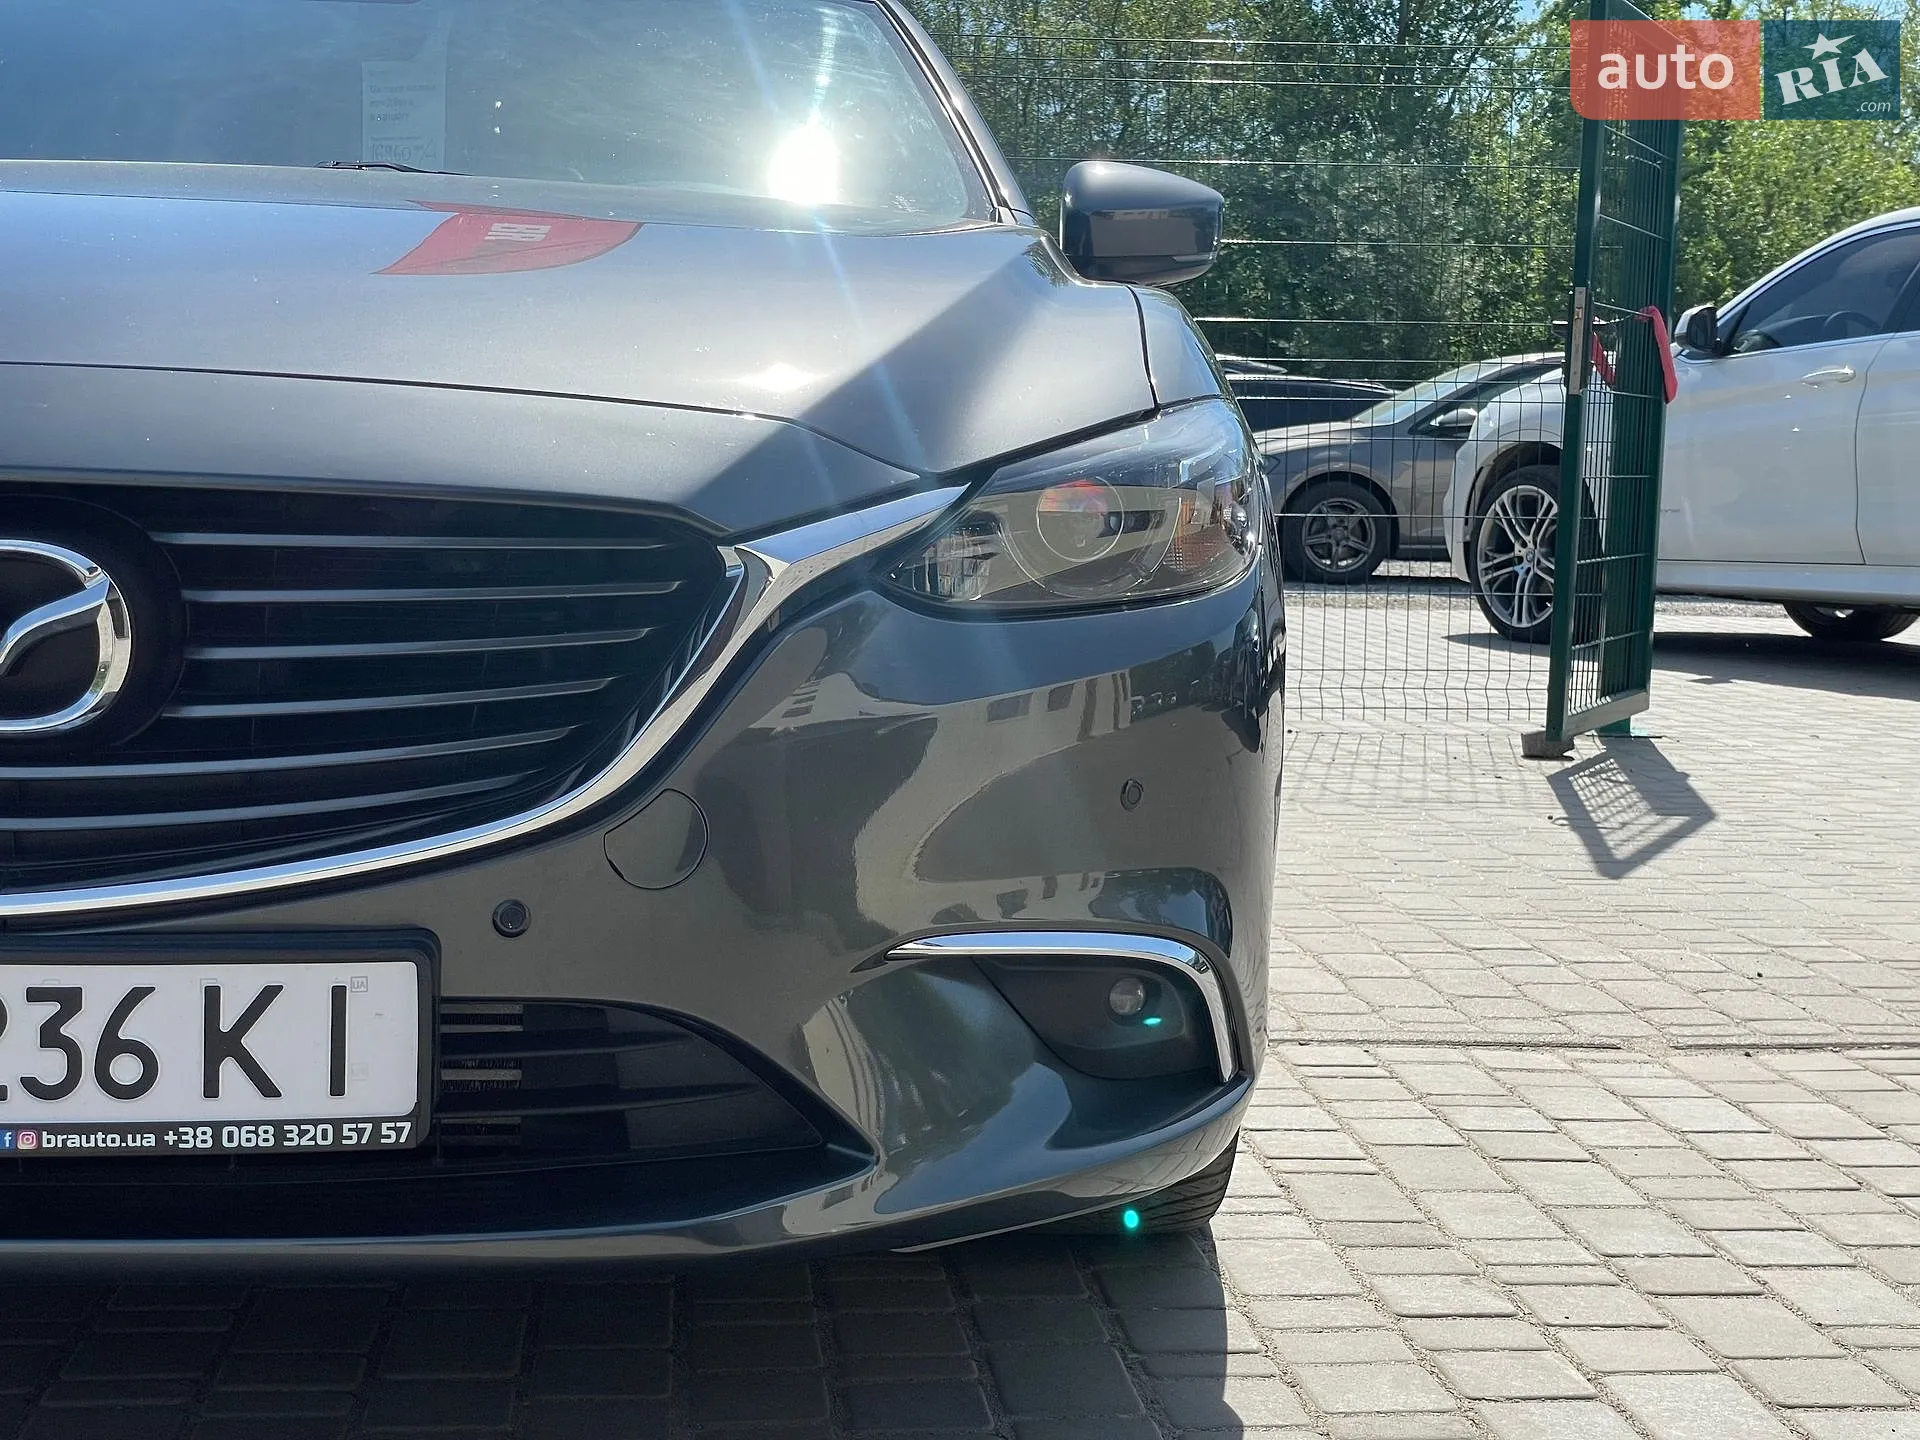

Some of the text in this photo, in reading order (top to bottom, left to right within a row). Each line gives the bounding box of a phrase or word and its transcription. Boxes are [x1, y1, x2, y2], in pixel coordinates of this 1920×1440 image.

[0, 985, 160, 1101] 36
[42, 1130, 156, 1149] brauto.ua
[164, 1126, 213, 1149] +38
[222, 1125, 275, 1148] 068
[283, 1123, 334, 1147] 320
[341, 1122, 373, 1145] 57
[380, 1121, 412, 1144] 57
